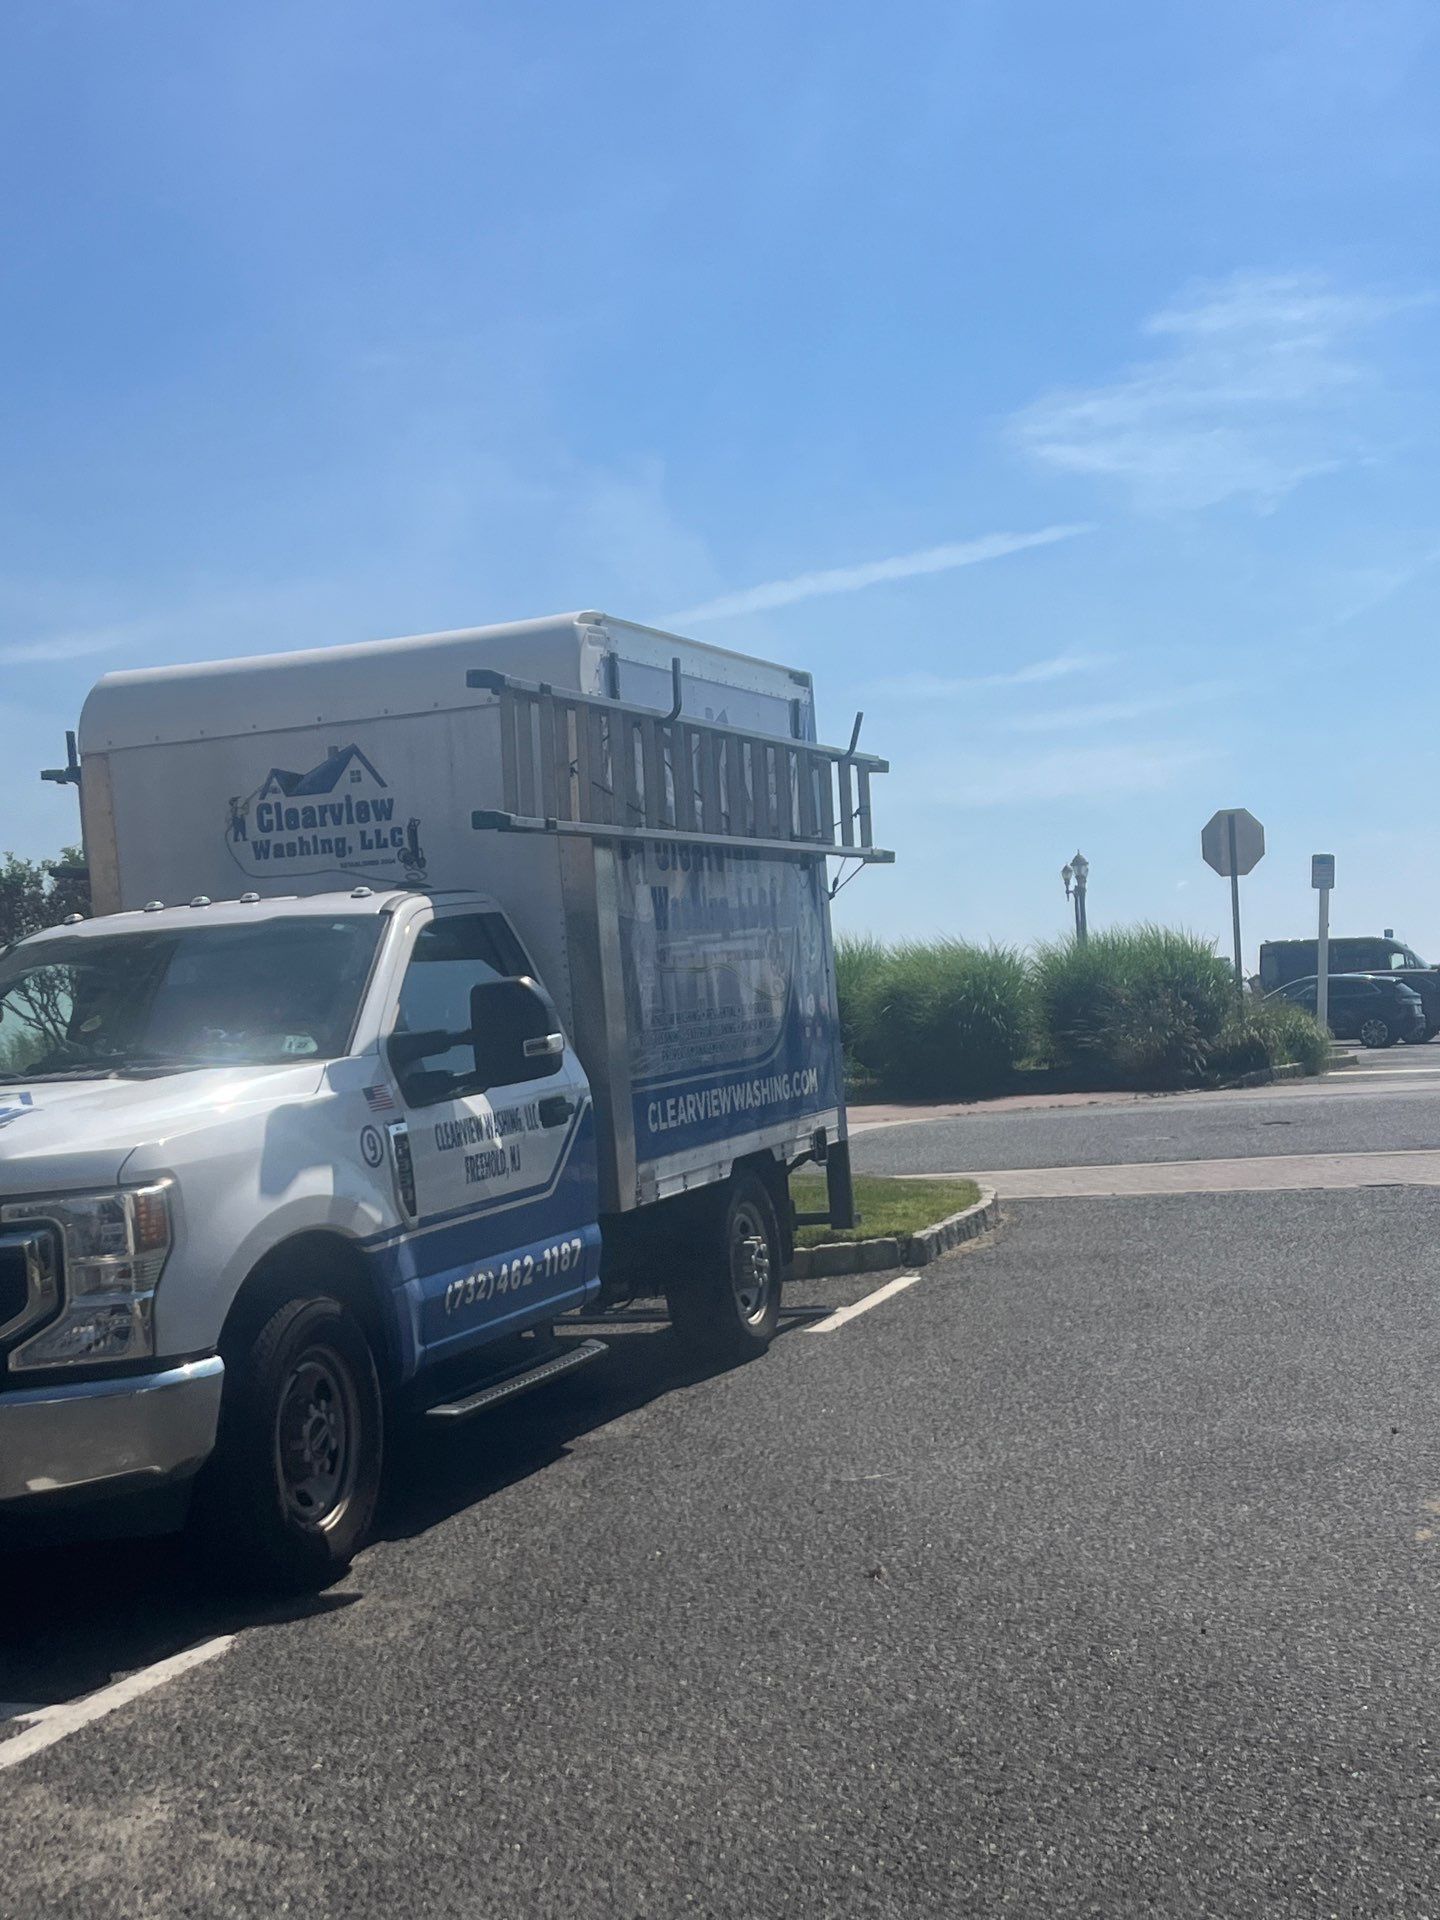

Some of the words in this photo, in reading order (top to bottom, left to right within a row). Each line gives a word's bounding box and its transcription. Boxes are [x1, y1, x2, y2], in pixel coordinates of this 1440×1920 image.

[256, 795, 394, 833] Clearview
[252, 834, 353, 861] Washing,
[360, 826, 404, 850] LLC
[647, 1067, 819, 1133] CLEARVIEWWASHING.COM
[366, 1133, 378, 1161] 9
[434, 1114, 484, 1151] CLEARVIEW
[464, 1148, 509, 1185] FREEHOLD,
[509, 1144, 521, 1172] NJ
[496, 1237, 582, 1294] 462-1187
